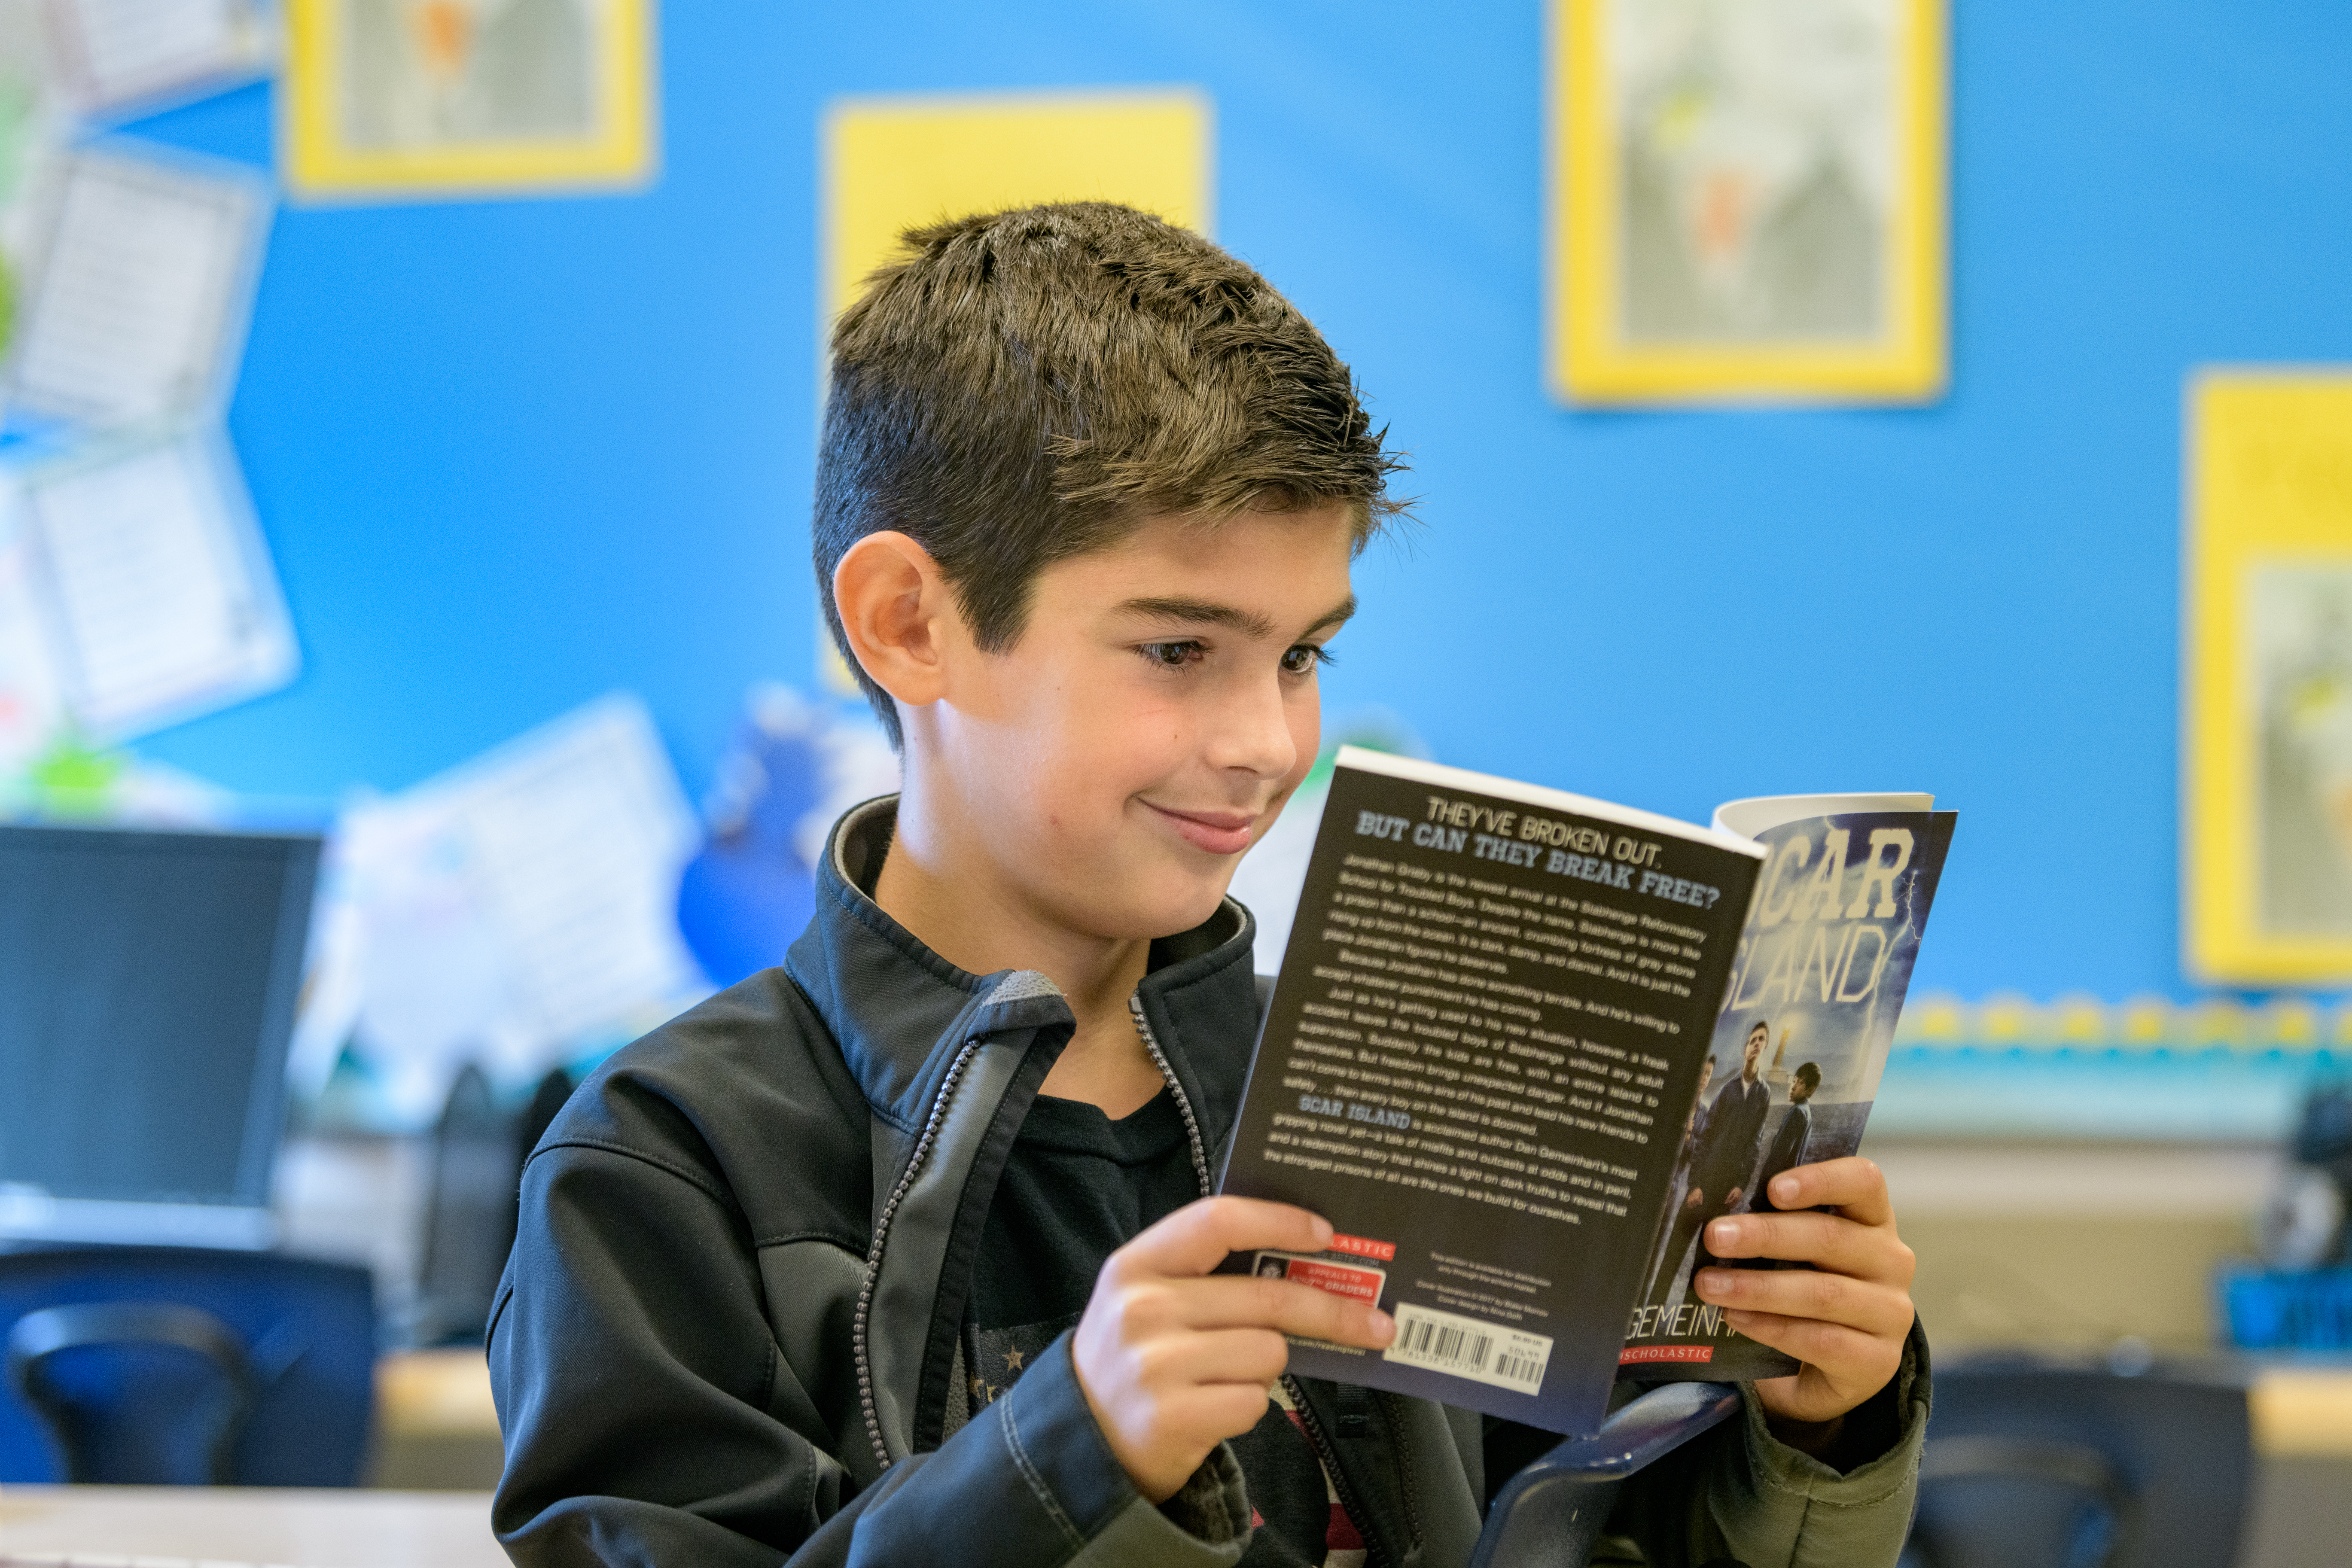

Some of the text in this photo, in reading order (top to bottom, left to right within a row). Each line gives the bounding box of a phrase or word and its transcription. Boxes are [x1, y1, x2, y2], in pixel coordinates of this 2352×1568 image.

[1429, 797, 1660, 867] THEY'VE BROKEN OUT.
[1357, 812, 1720, 909] BUT CAN THEY BREAK FREE?
[1299, 1095, 1343, 1116] SCAR
[1348, 1104, 1410, 1128] ISLAND
[1326, 1282, 1372, 1296] GRADERS
[1624, 1349, 1710, 1361] SCHOLASTIC
